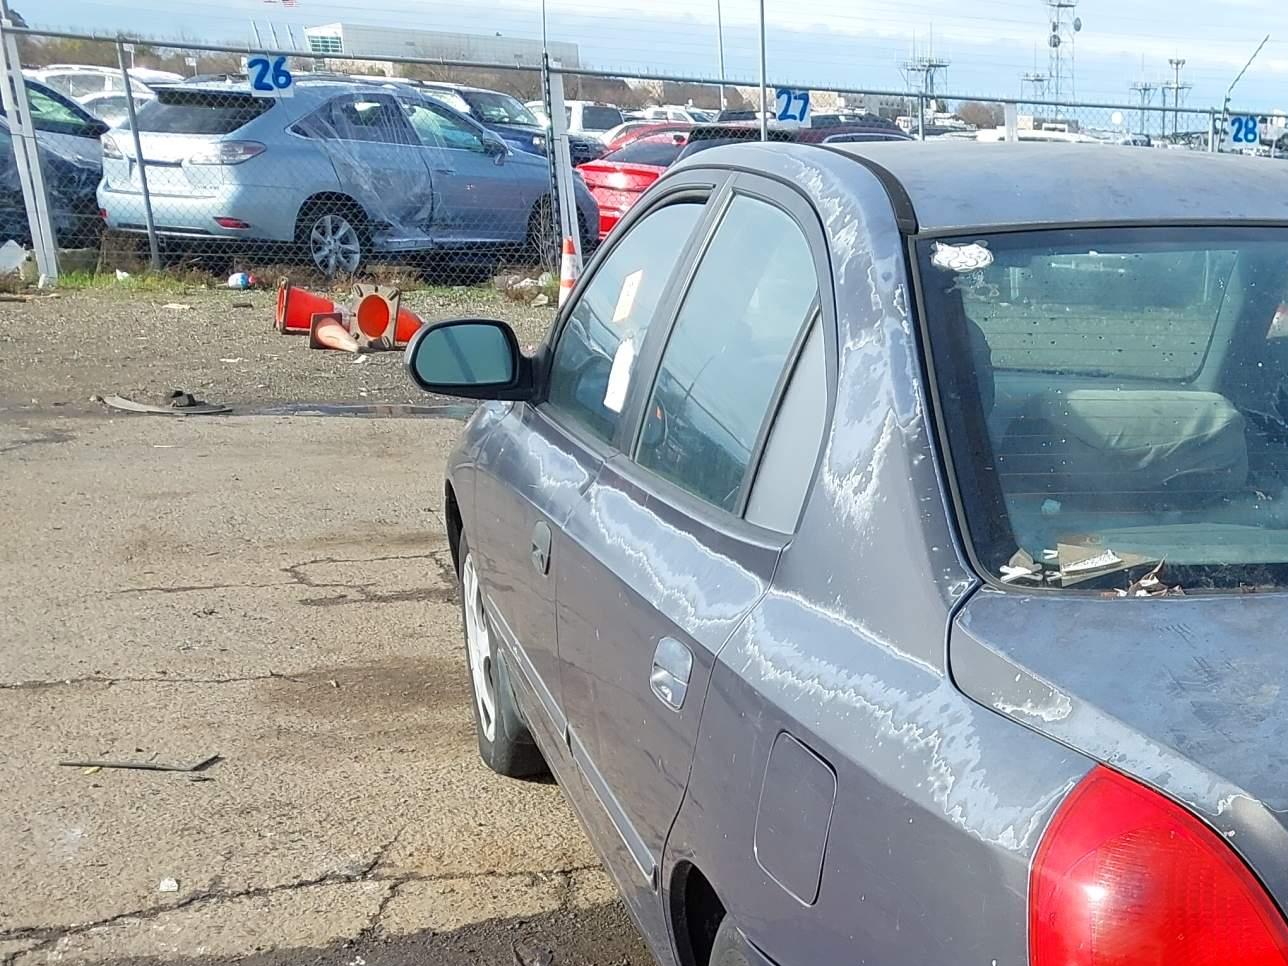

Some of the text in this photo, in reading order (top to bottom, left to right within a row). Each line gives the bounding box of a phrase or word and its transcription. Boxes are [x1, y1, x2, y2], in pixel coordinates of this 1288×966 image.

[247, 56, 292, 91] 26
[776, 88, 810, 122] 27
[1231, 115, 1257, 143] 28
